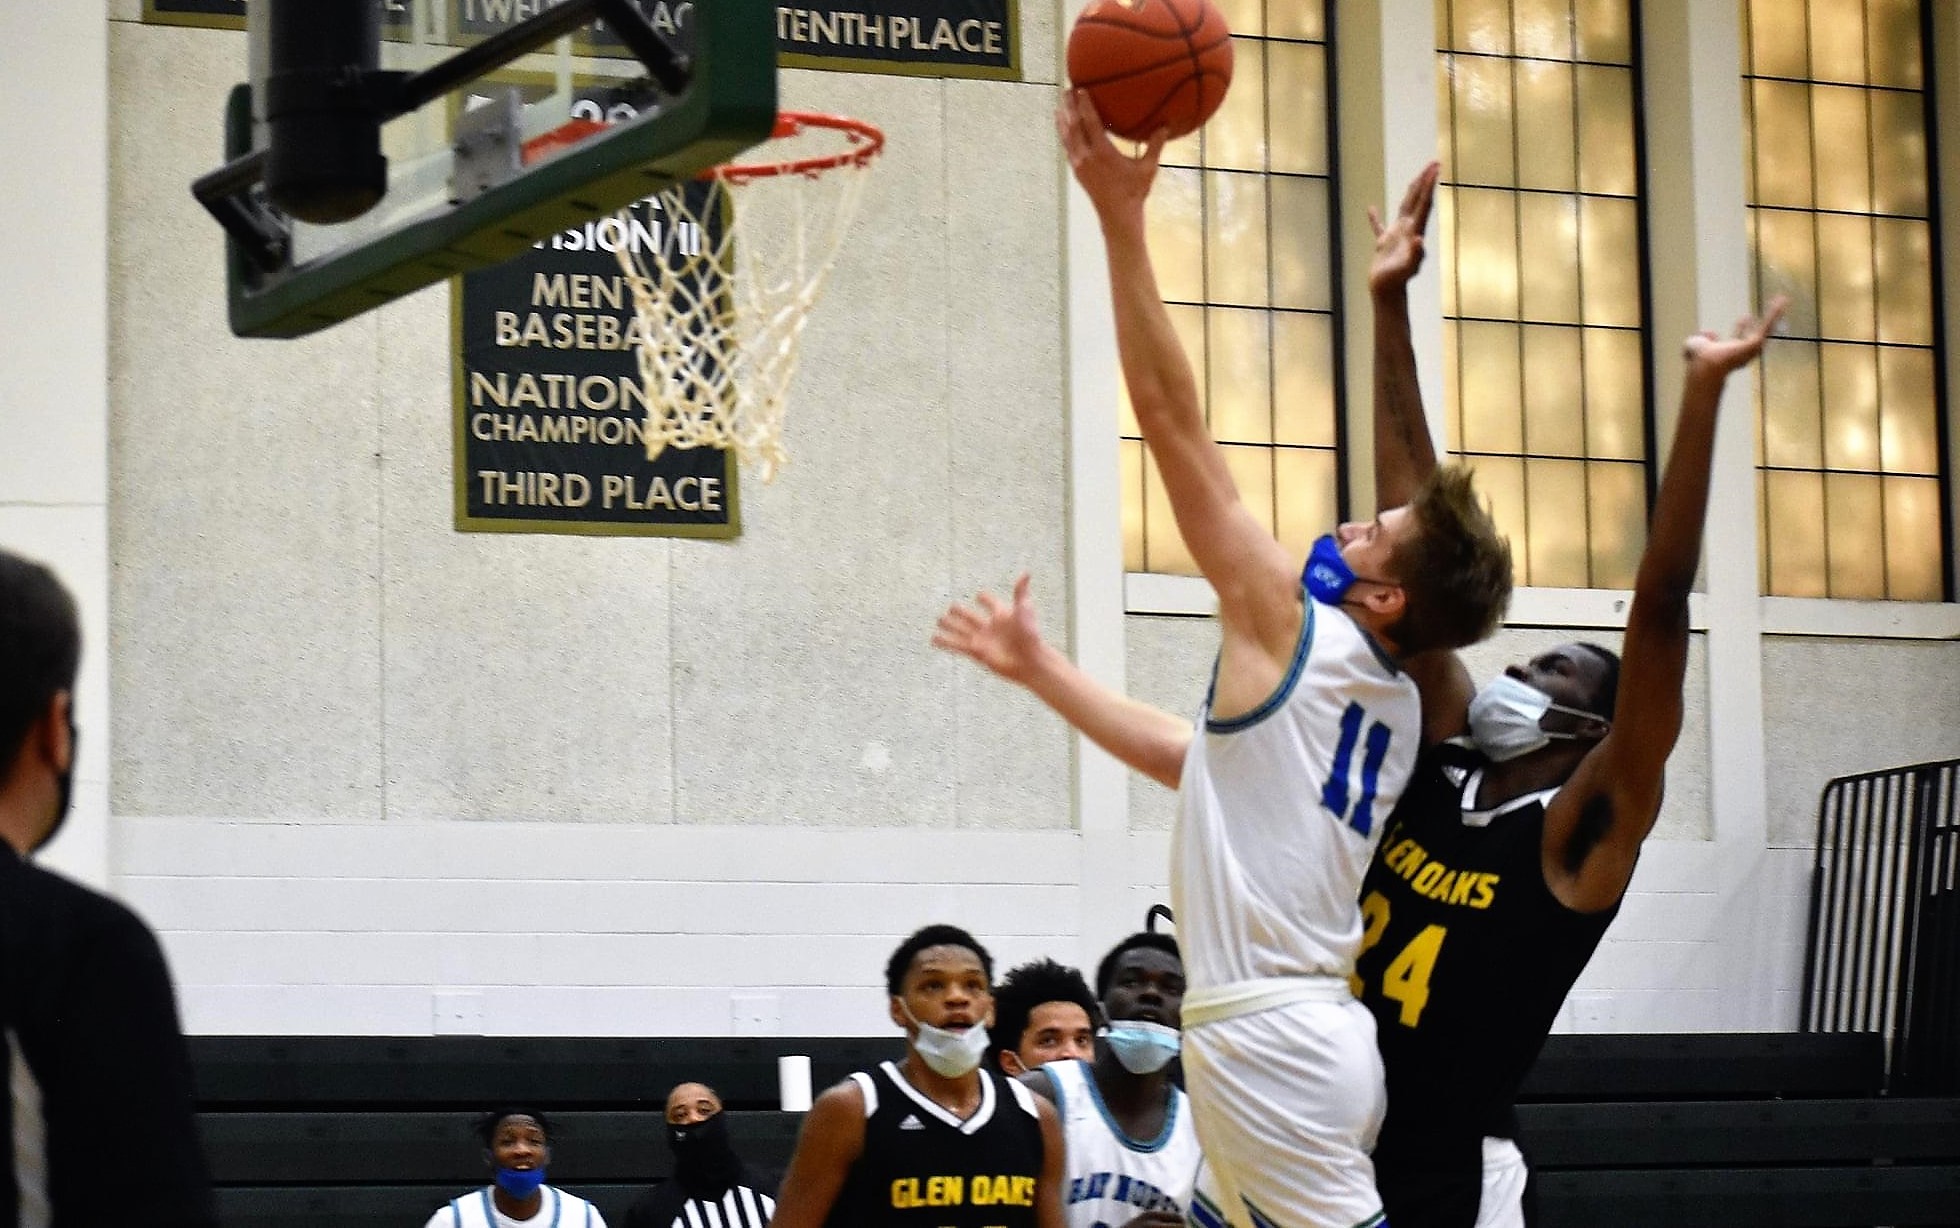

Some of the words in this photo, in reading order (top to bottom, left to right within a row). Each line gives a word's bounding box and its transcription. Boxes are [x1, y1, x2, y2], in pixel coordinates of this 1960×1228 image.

[776, 6, 885, 49] TENTH
[889, 16, 1003, 55] PLACE
[679, 221, 701, 257] II
[495, 311, 645, 351] BASEBA
[471, 372, 650, 412] NATION
[471, 413, 648, 445] CHAMPION
[477, 470, 592, 508] THIRD
[602, 475, 722, 512] PLACE
[1321, 700, 1392, 838] 11
[1411, 861, 1501, 910] OAKS
[890, 1175, 965, 1209] GLEN
